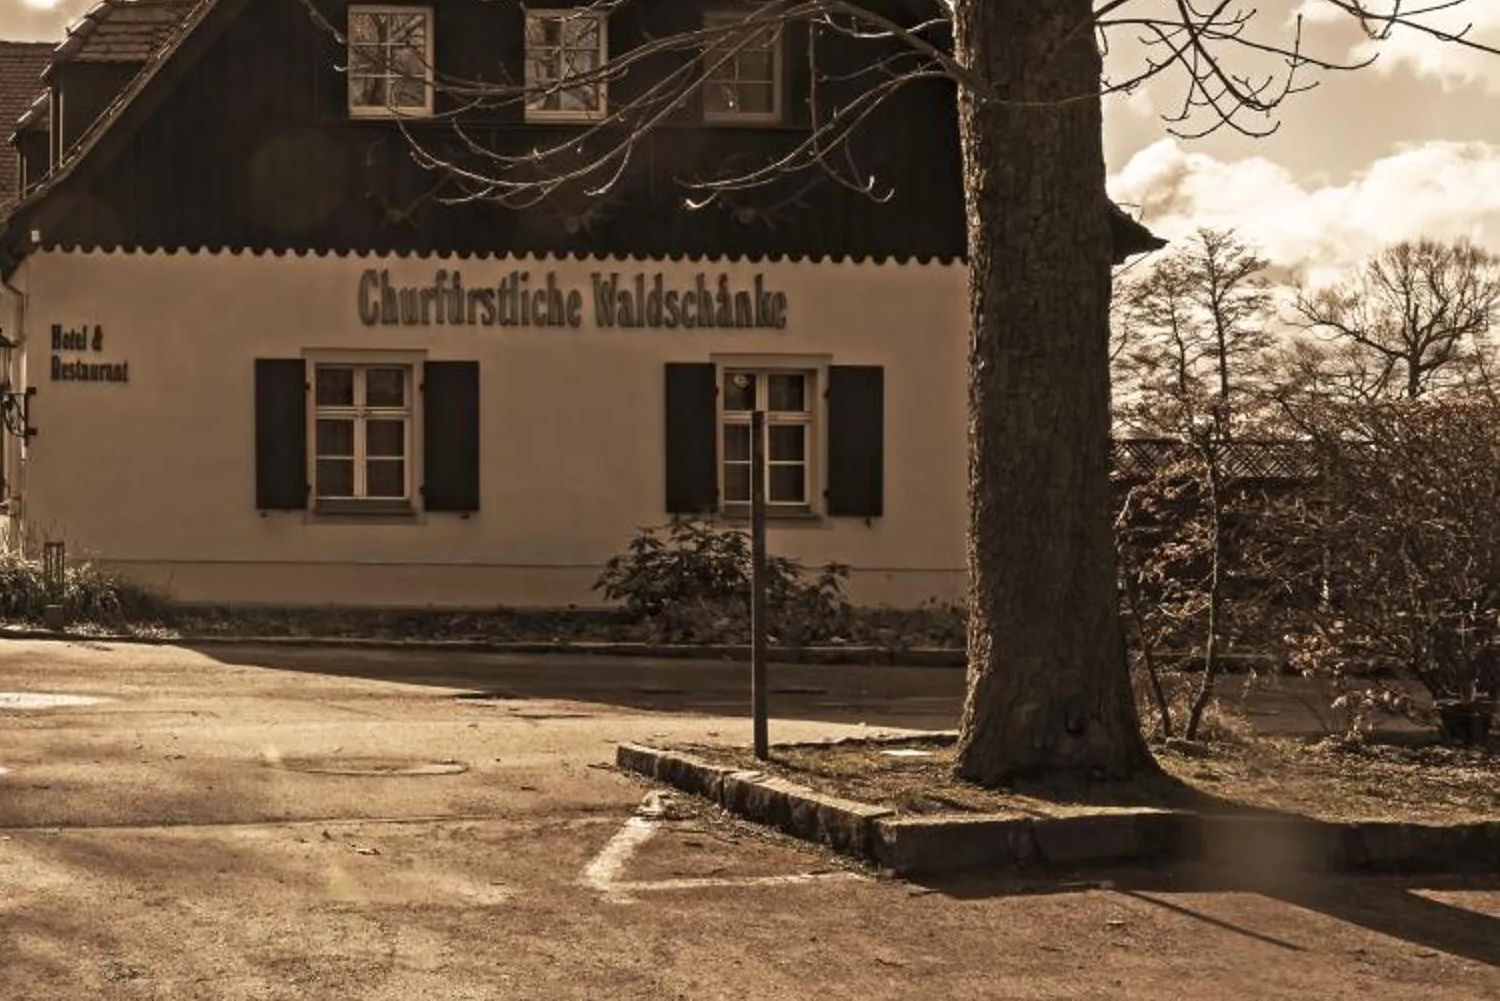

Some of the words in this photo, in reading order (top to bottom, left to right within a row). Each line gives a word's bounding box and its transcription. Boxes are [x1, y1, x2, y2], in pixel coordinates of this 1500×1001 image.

[51, 324, 87, 350] Hotel
[91, 324, 103, 351] &
[51, 355, 129, 383] Restaurant
